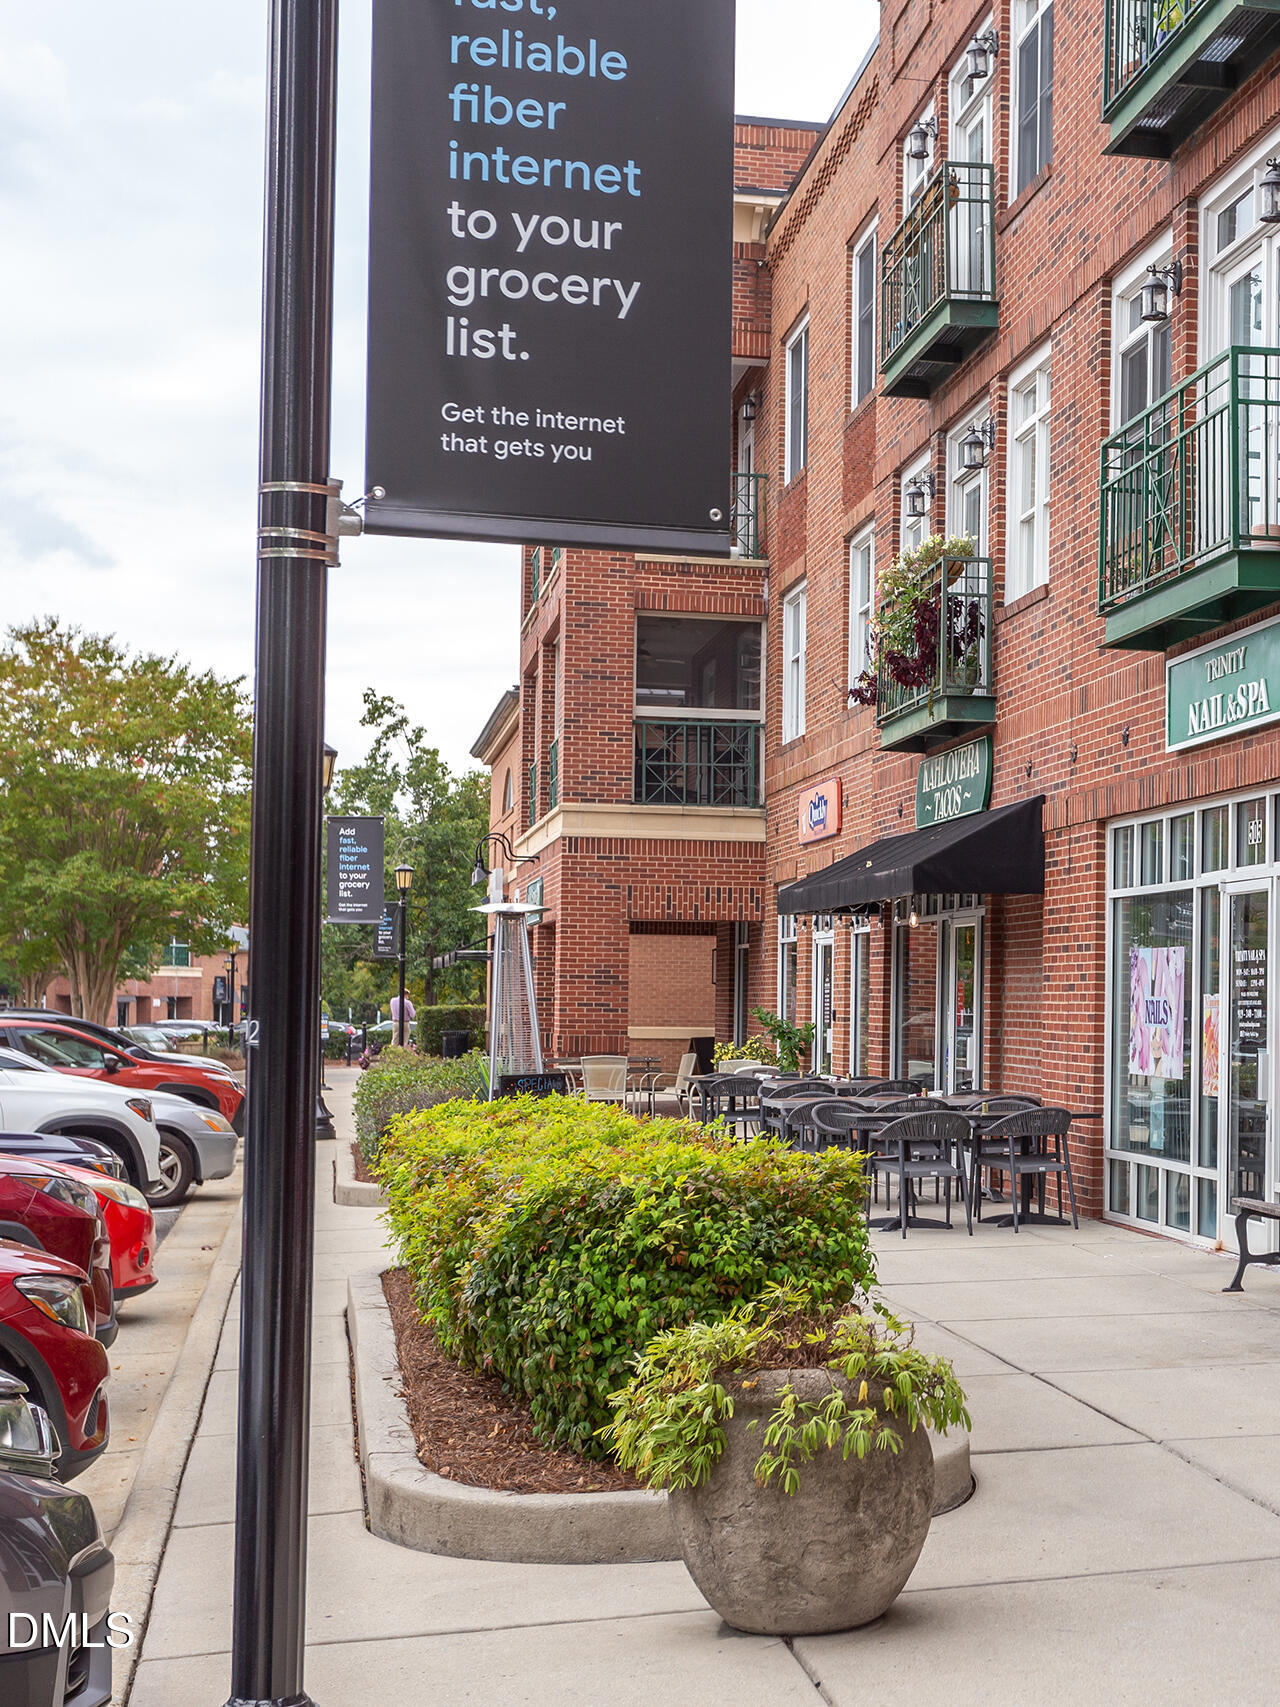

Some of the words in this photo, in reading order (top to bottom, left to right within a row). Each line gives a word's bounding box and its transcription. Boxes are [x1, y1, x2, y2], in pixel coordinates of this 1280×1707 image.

[451, 28, 628, 81] reliable
[448, 83, 567, 130] fiber
[449, 139, 642, 197] internet
[446, 200, 498, 240] to
[511, 212, 624, 253] your
[446, 265, 642, 320] grocery
[446, 315, 530, 361] list.
[440, 402, 486, 425] Get
[491, 406, 530, 427] the
[535, 408, 626, 435] internet
[440, 432, 488, 454] that
[494, 438, 546, 460] gets
[551, 443, 593, 464] you
[1205, 646, 1248, 683] TRINITY
[922, 742, 980, 793] KAHLOVERA
[933, 784, 962, 821] TACOS
[339, 828, 356, 836] Add
[339, 836, 357, 845] fast,
[1248, 820, 1262, 844] 505
[339, 845, 368, 854] reliable
[339, 854, 359, 862] fiber
[339, 863, 370, 871] internet
[339, 872, 348, 880] to
[349, 873, 368, 882] your
[339, 881, 370, 890] grocery
[339, 890, 353, 898] list.
[1145, 999, 1169, 1026] NAILS
[241, 1020, 260, 1044] 12
